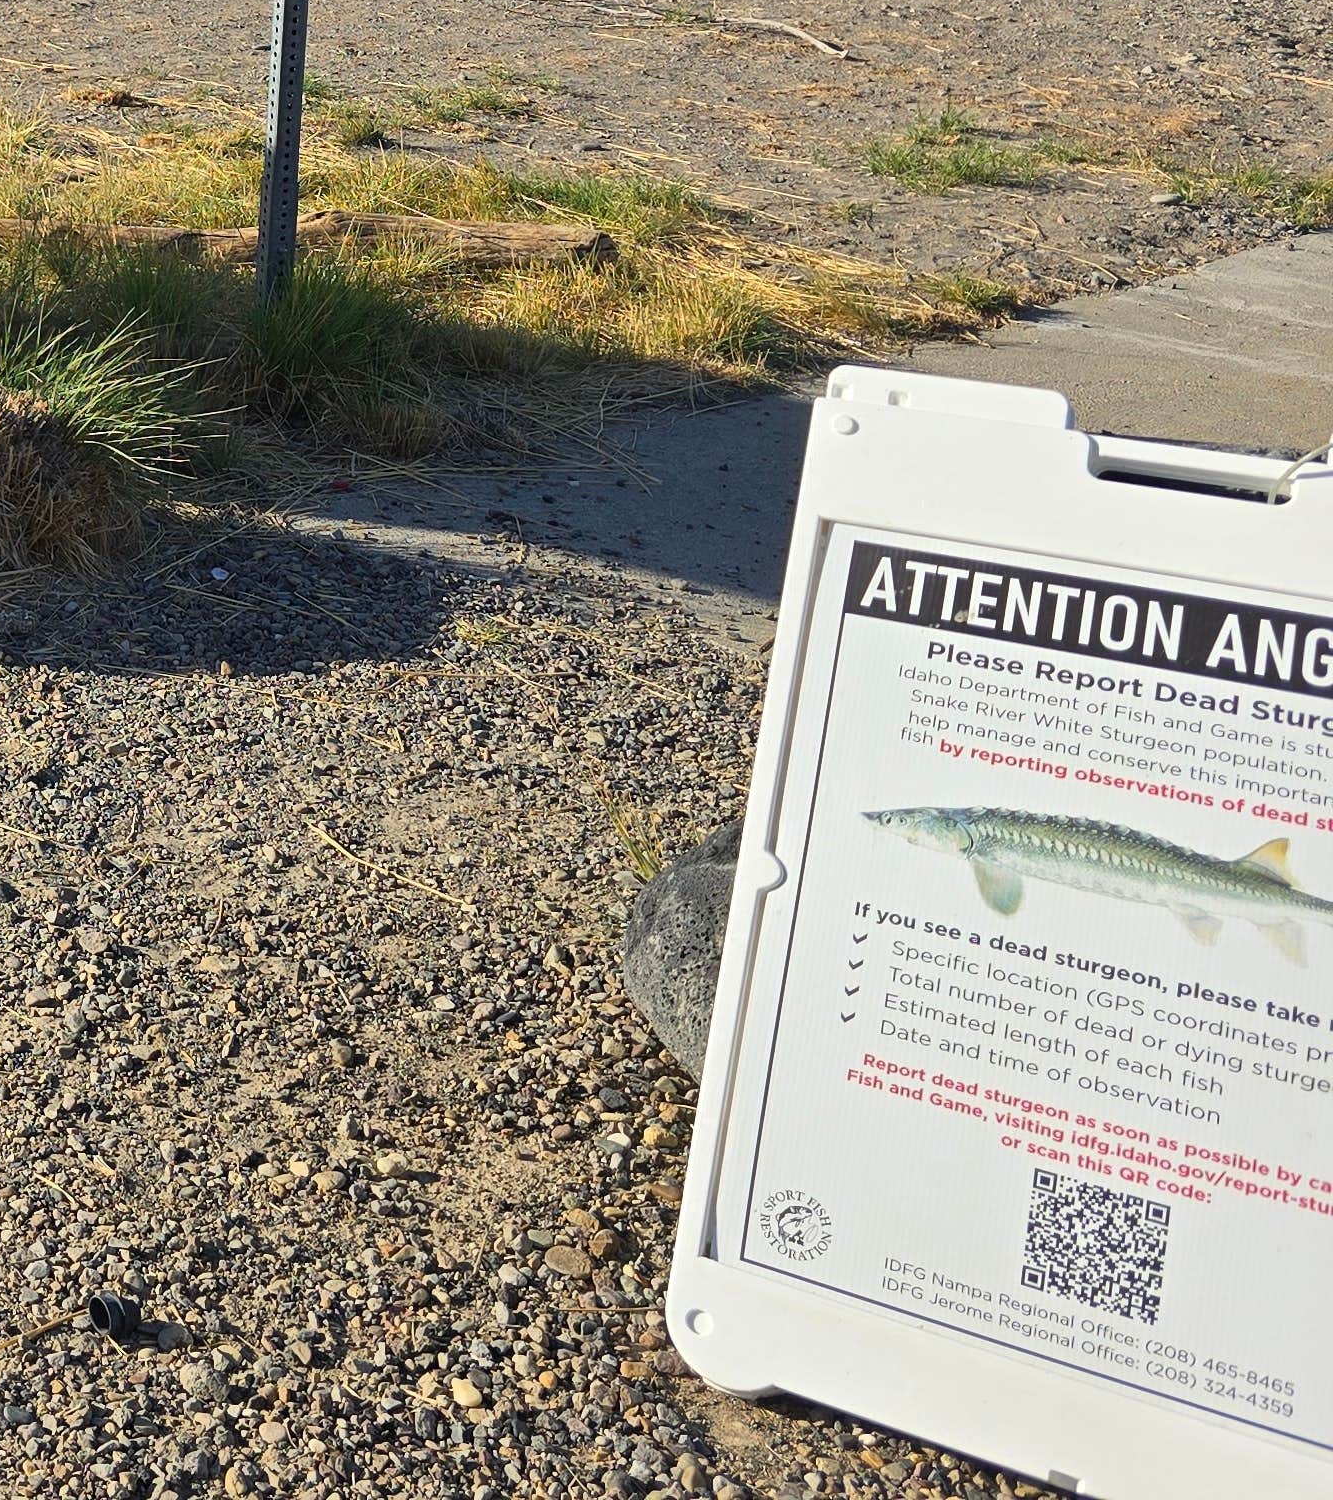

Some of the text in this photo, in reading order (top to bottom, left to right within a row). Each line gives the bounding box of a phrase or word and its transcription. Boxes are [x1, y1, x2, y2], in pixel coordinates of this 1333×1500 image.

[860, 557, 1333, 687] ATTENTION ANG
[928, 642, 1023, 675] Please
[1036, 661, 1143, 697] Report
[1155, 683, 1239, 715] Dead
[855, 902, 870, 917] If
[877, 910, 915, 929] you
[924, 922, 961, 939] see
[969, 933, 980, 945] a
[990, 936, 1047, 961] dead
[1055, 954, 1167, 993] sturgeon,
[1177, 983, 1257, 1011] please
[1267, 1002, 1320, 1027] take
[881, 1020, 1220, 1124] Date and time of observation
[760, 1190, 833, 1261] SPORT FISH RESTORATION
[885, 1258, 1294, 1396] IDFG Nampa Regional Office: (208) 465-8465
